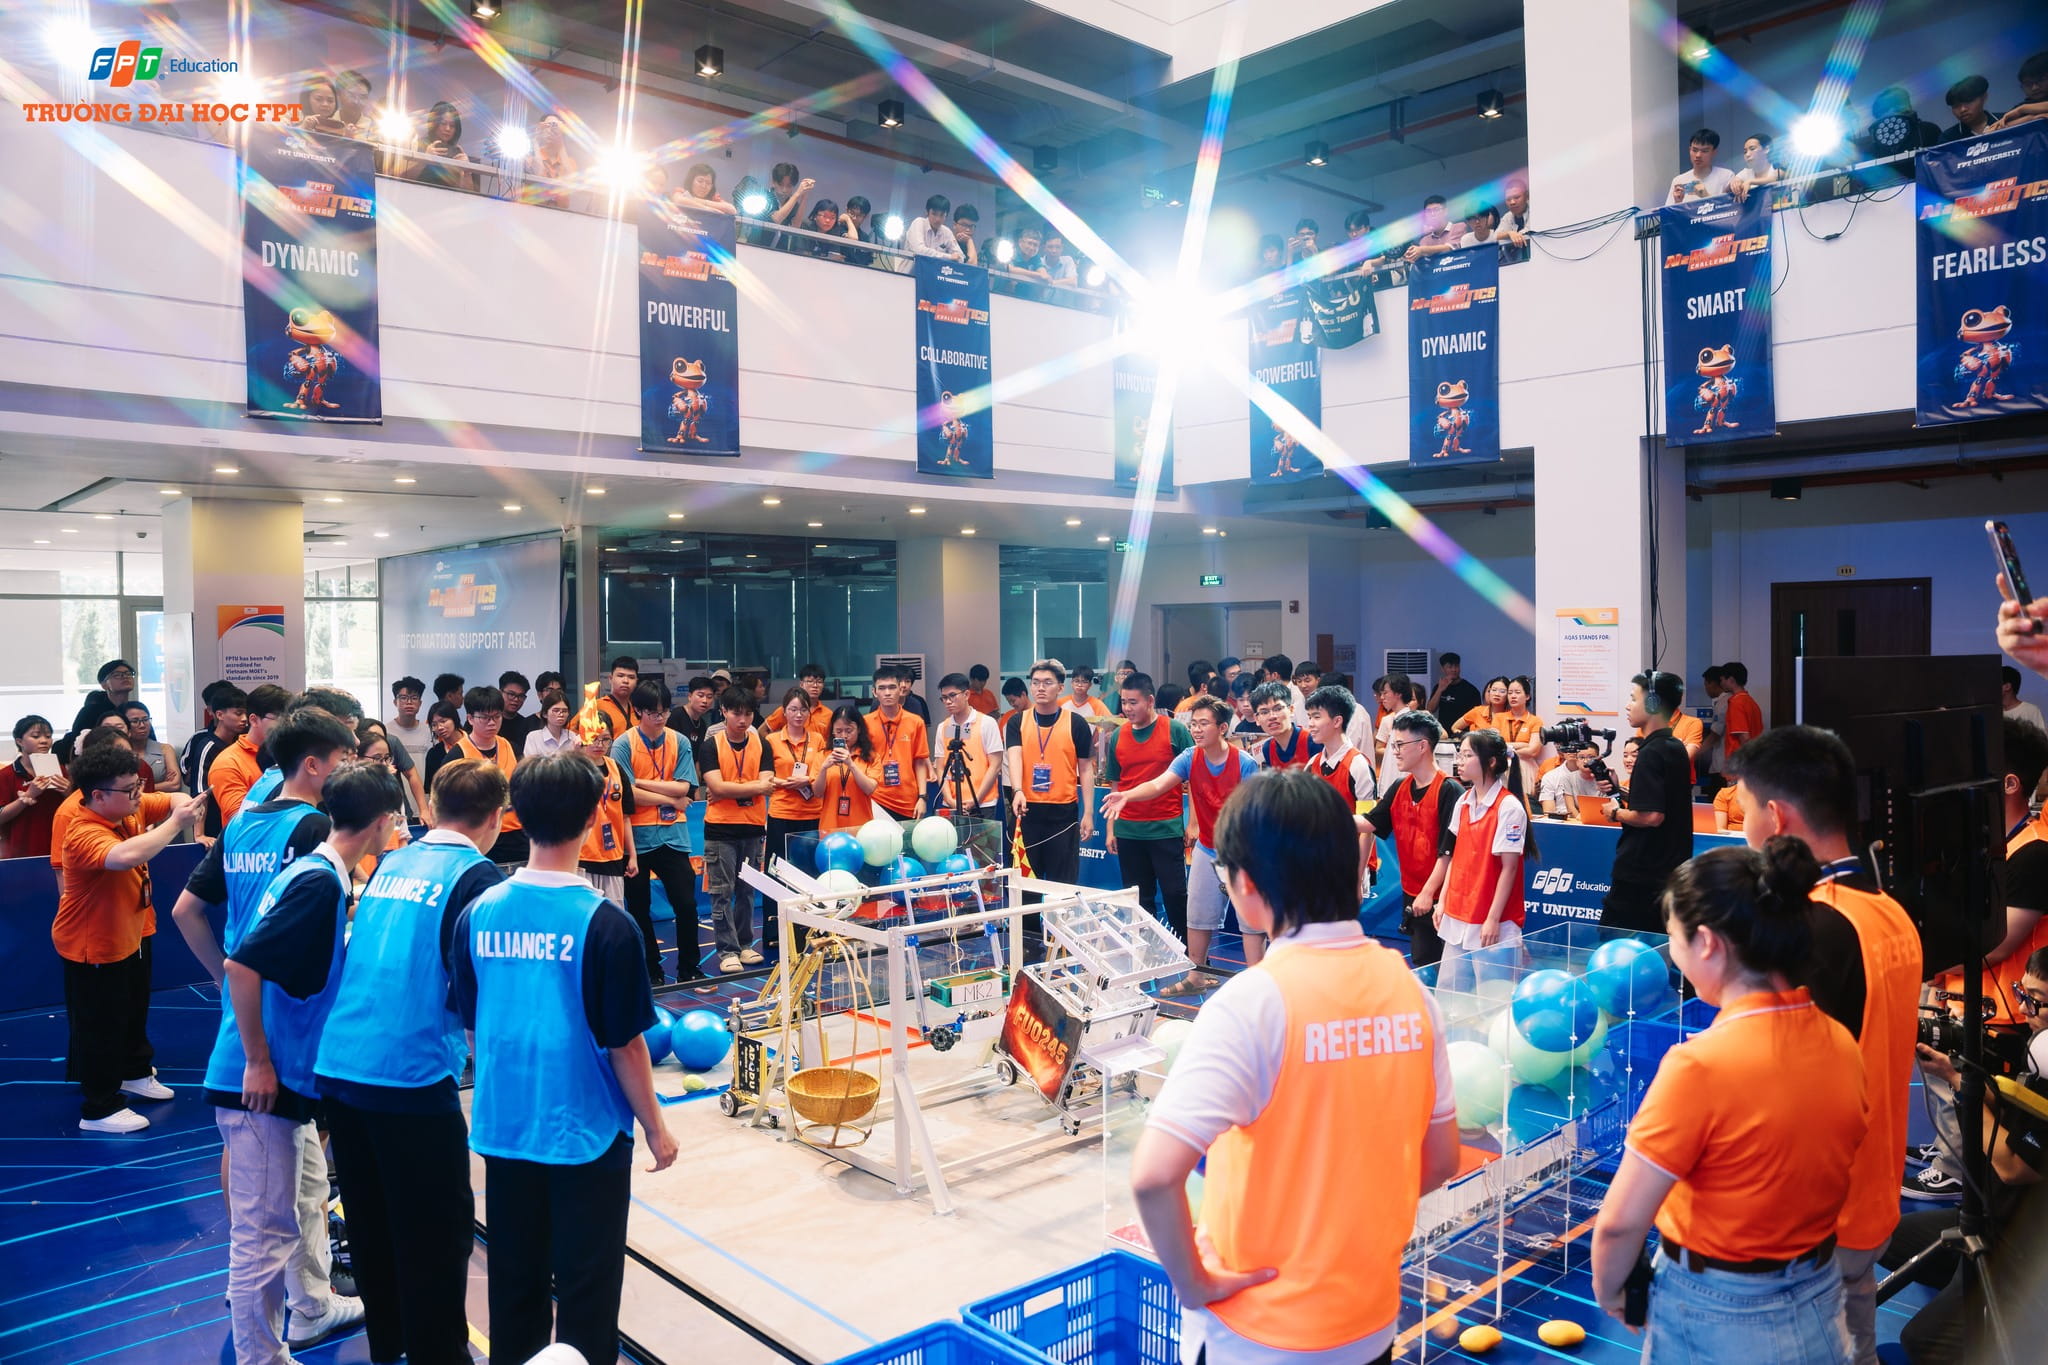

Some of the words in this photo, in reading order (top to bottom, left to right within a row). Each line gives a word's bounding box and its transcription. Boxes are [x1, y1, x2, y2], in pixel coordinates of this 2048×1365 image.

[1973, 148, 2021, 166] UNIVERSITY
[262, 240, 359, 277] DYNAMIC
[1932, 236, 2047, 281] FEARLESS
[647, 300, 730, 332] POWERFUL
[1687, 288, 1746, 320] SMART
[920, 345, 988, 370] COLLABORATIVE
[1422, 330, 1487, 358] DYNAMIC
[1255, 360, 1316, 384] POWERFUL
[399, 633, 457, 650] INFORMATION
[458, 632, 504, 649] SUPPORT
[508, 631, 537, 649] AREA
[365, 875, 431, 904] ALLIANCE
[426, 883, 443, 907] 2
[1533, 870, 1573, 893] FPT
[1524, 901, 1540, 913] PT
[476, 930, 557, 960] ALLIANCE
[560, 934, 574, 962] 2
[964, 981, 993, 1002] MK2
[1304, 1011, 1424, 1064] REFEREE
